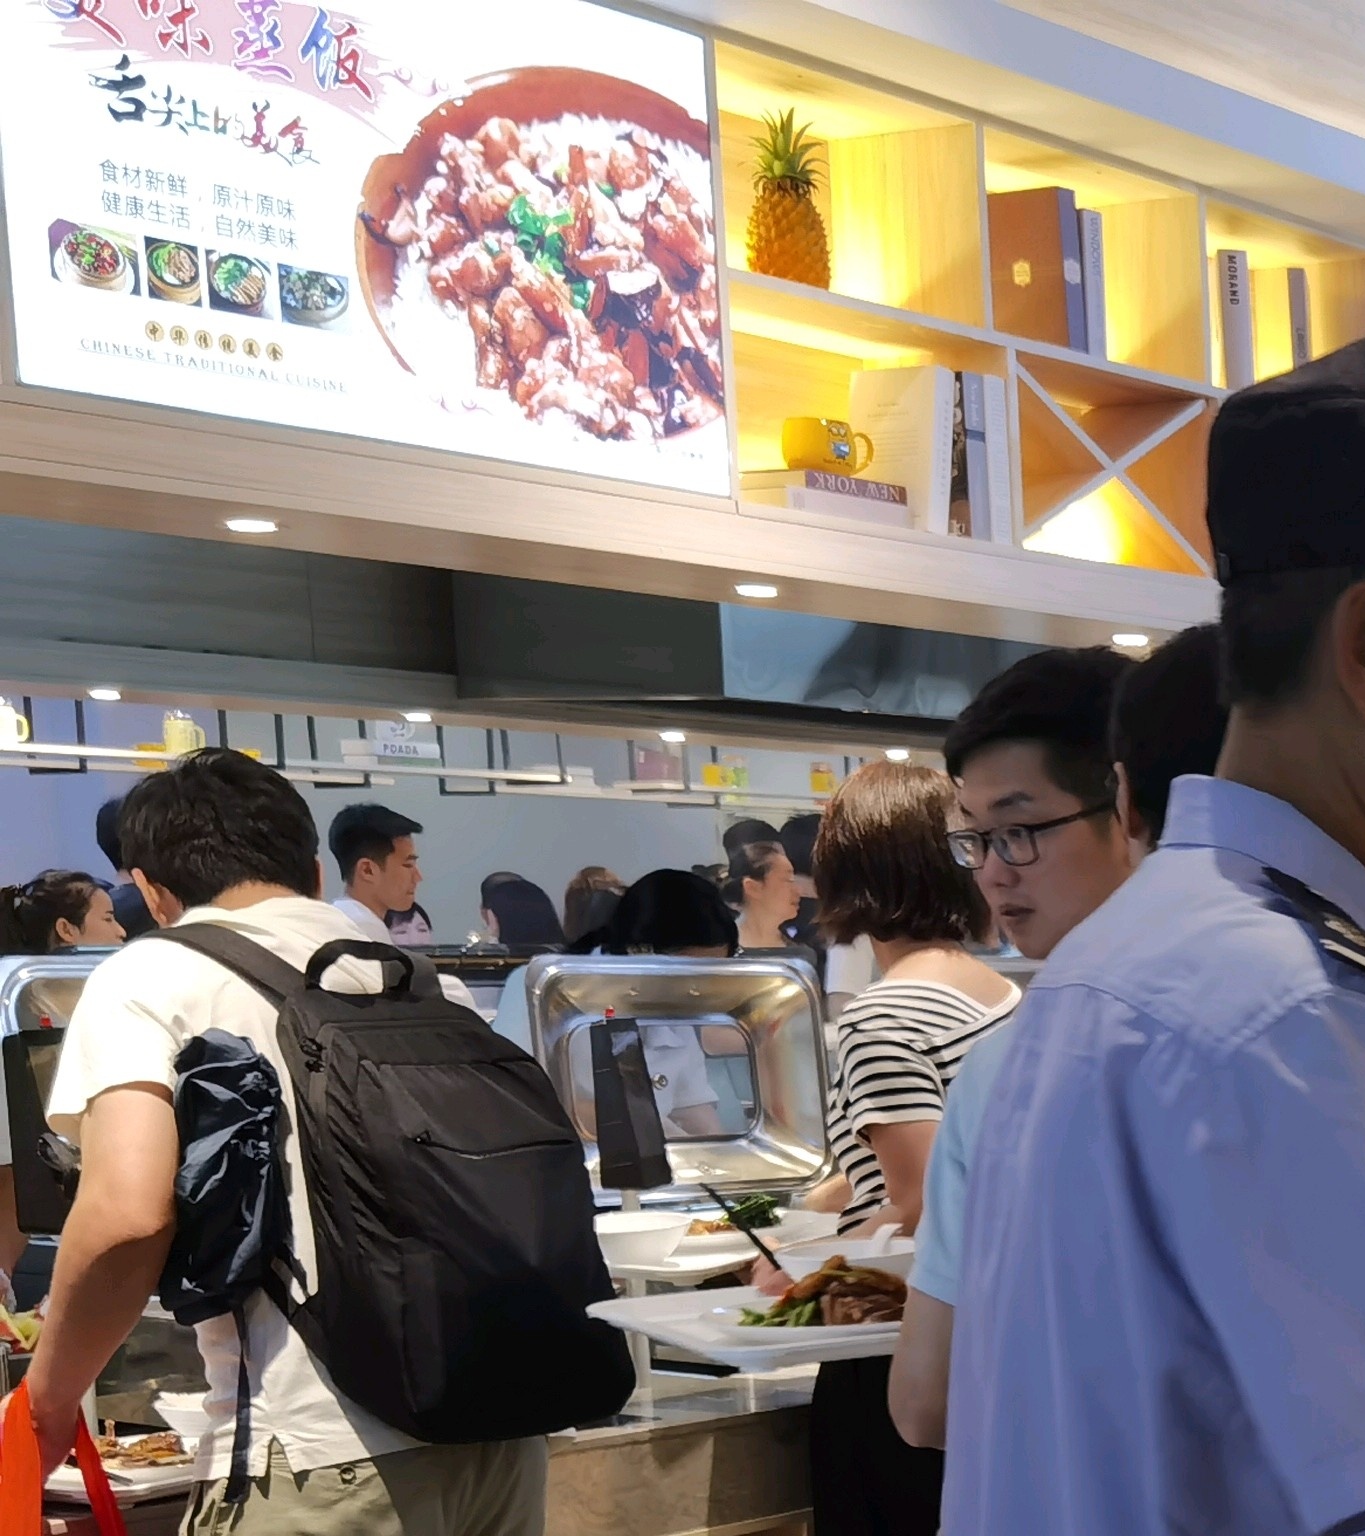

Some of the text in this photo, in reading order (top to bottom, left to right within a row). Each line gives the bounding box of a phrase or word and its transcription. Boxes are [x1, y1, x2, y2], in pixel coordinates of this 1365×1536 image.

[88, 54, 320, 166] 舌尖上的美食
[1227, 254, 1240, 306] MORAND
[80, 337, 347, 393] CHINESE TRADITIONAL CUISINE
[814, 471, 900, 502] NEW YORK
